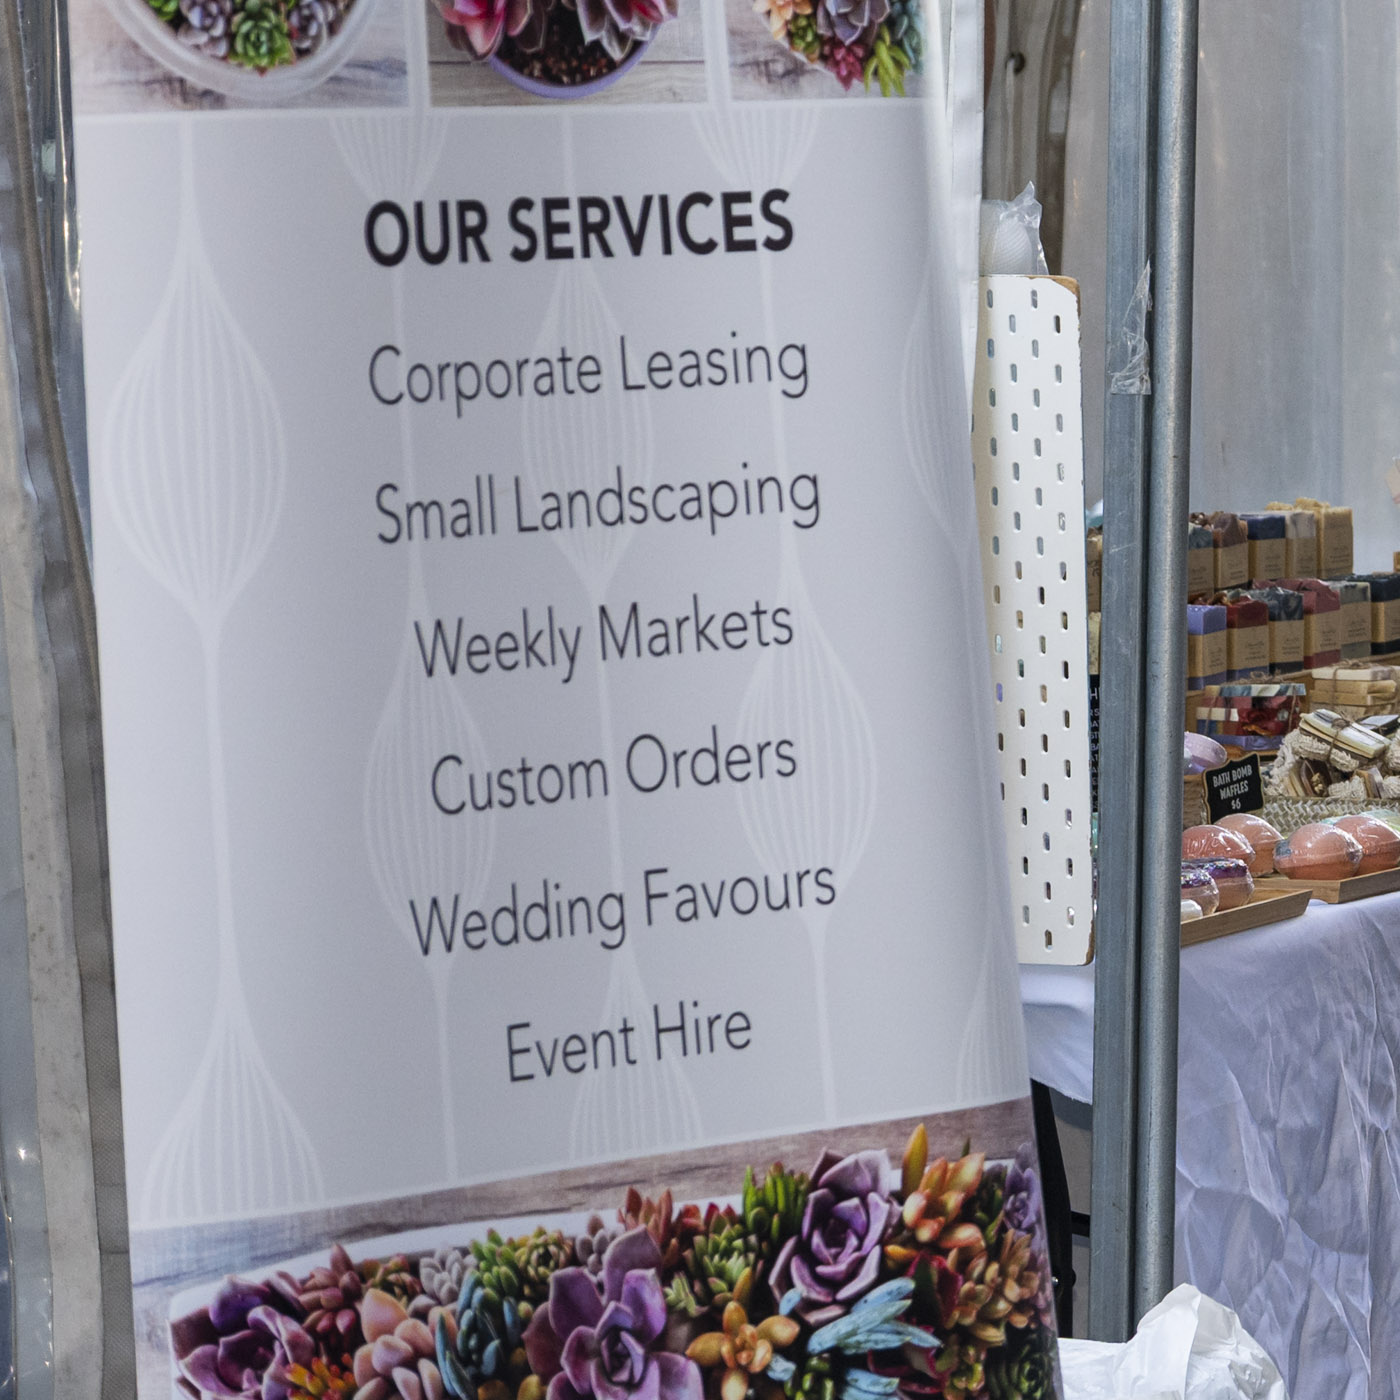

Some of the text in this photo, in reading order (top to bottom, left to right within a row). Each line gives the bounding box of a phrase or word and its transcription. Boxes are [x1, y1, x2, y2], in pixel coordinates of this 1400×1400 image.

[365, 189, 793, 267] OUR SERVICES
[369, 331, 808, 418] Corporate Leasing
[376, 462, 819, 544] Small Landscaping
[414, 594, 792, 684] Weekly Markets
[432, 725, 796, 815] Custom Orders
[1212, 764, 1252, 787] BATH BOMB
[1220, 780, 1249, 800] WAFFLES
[409, 868, 835, 956] Wedding Favours
[507, 1001, 751, 1082] Event Hire
